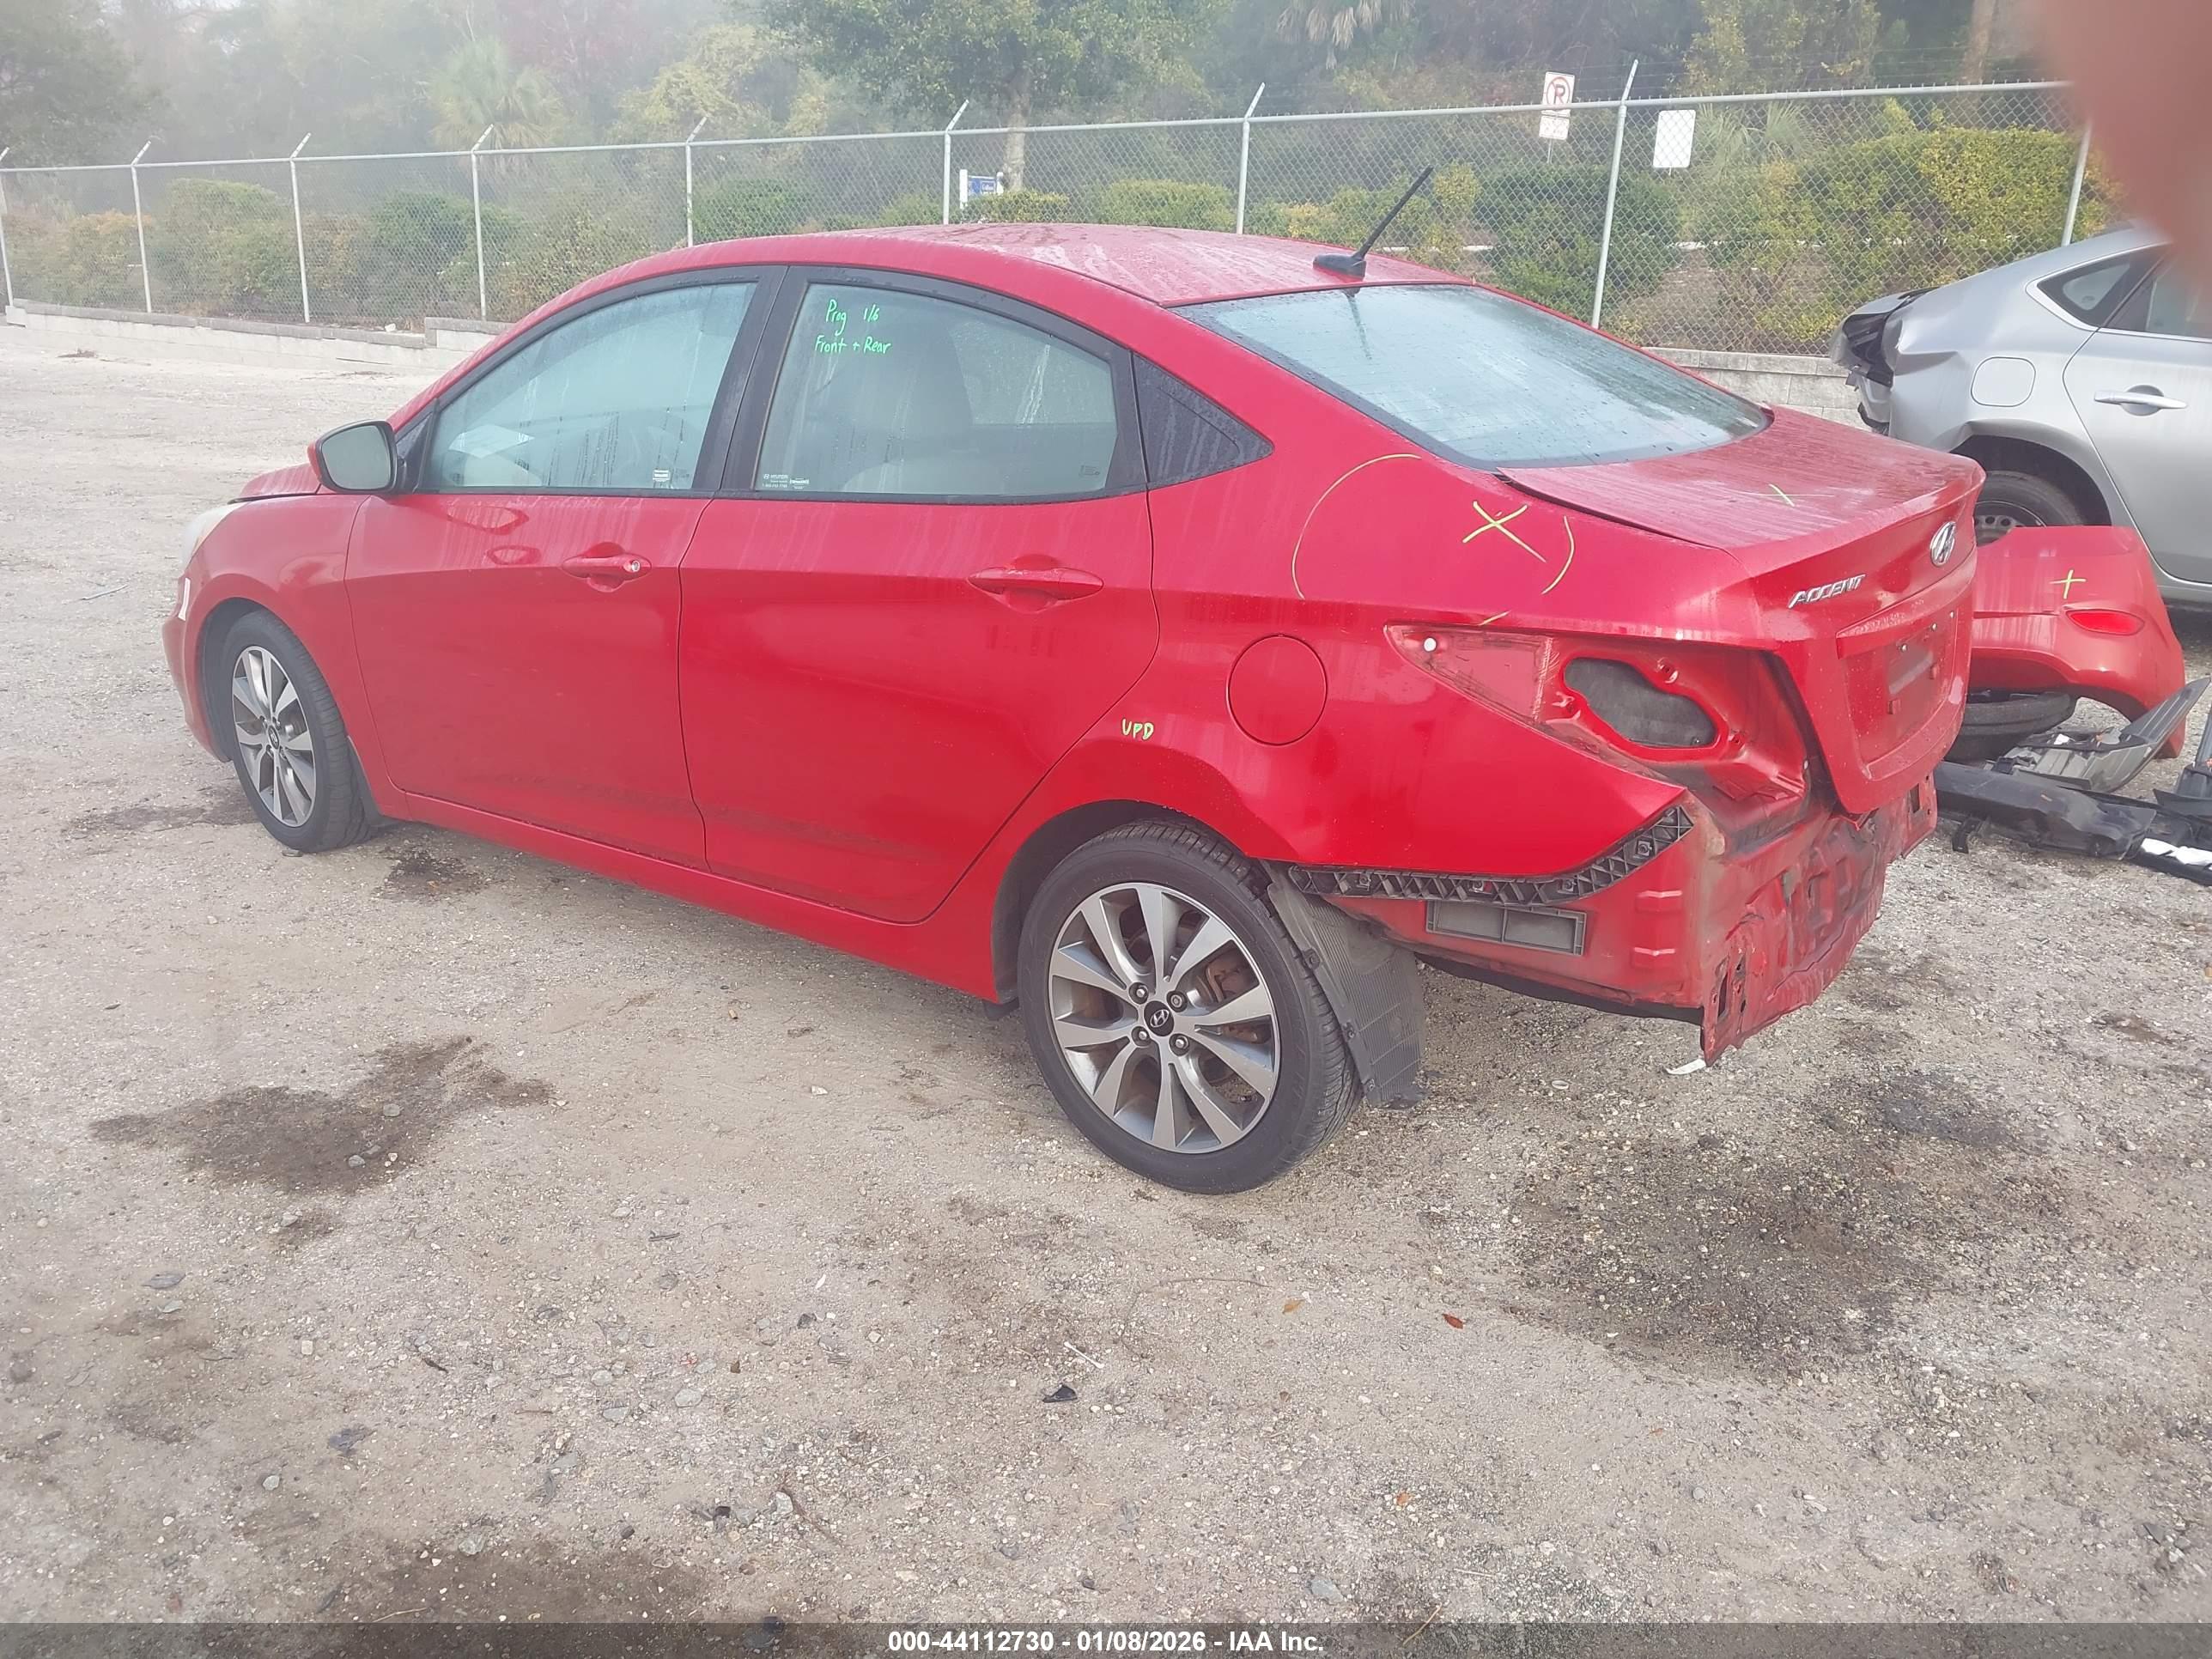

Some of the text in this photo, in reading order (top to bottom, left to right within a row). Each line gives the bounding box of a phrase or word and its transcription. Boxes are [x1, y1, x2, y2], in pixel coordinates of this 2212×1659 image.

[862, 304, 880, 322] 1/6
[815, 335, 848, 353] Front
[863, 336, 891, 354] Rear
[1788, 574, 1866, 609] ACCENT
[1121, 718, 1154, 740] UPD
